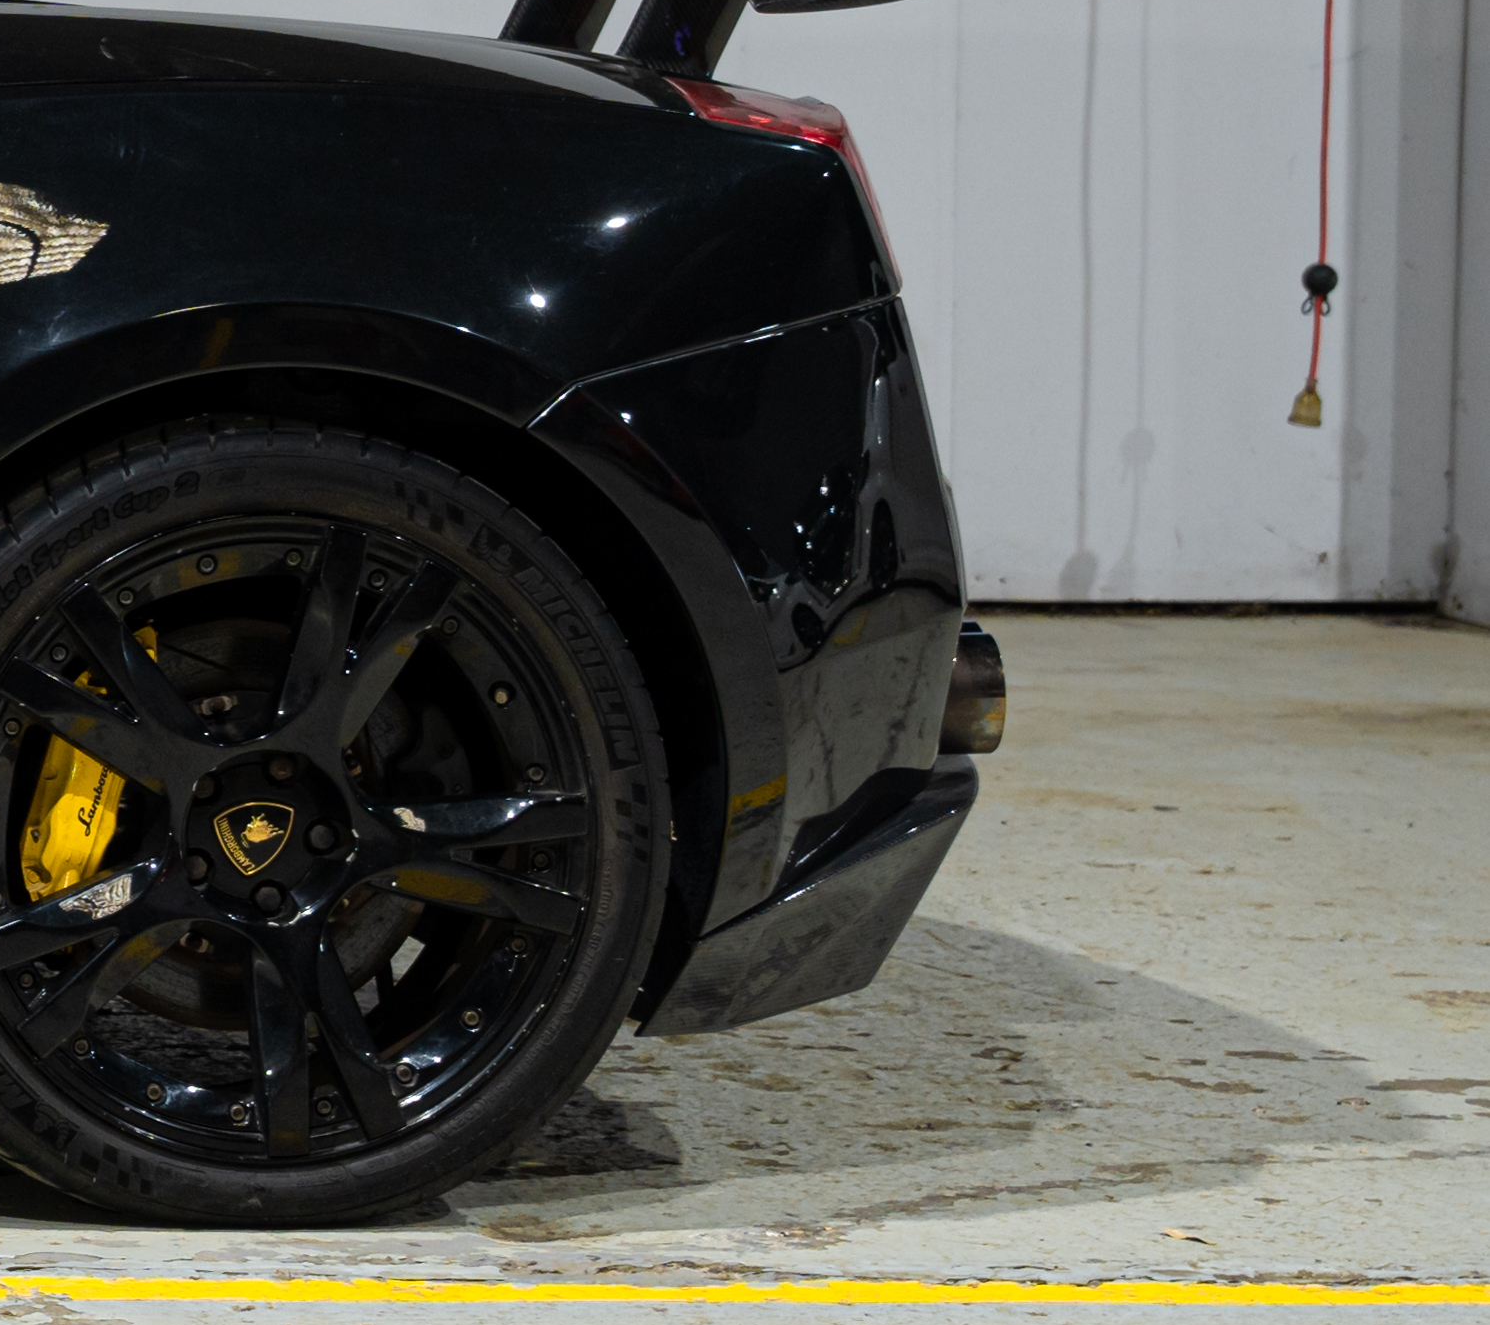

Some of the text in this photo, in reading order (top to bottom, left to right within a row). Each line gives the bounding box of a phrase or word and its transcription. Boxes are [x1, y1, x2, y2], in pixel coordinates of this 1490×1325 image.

[31, 507, 110, 576] Sport
[112, 486, 170, 519] Cup
[174, 471, 200, 497] 2
[517, 566, 640, 763] MICHELIN
[78, 764, 112, 837] Lambor
[218, 817, 255, 871] LAMBORGHINI
